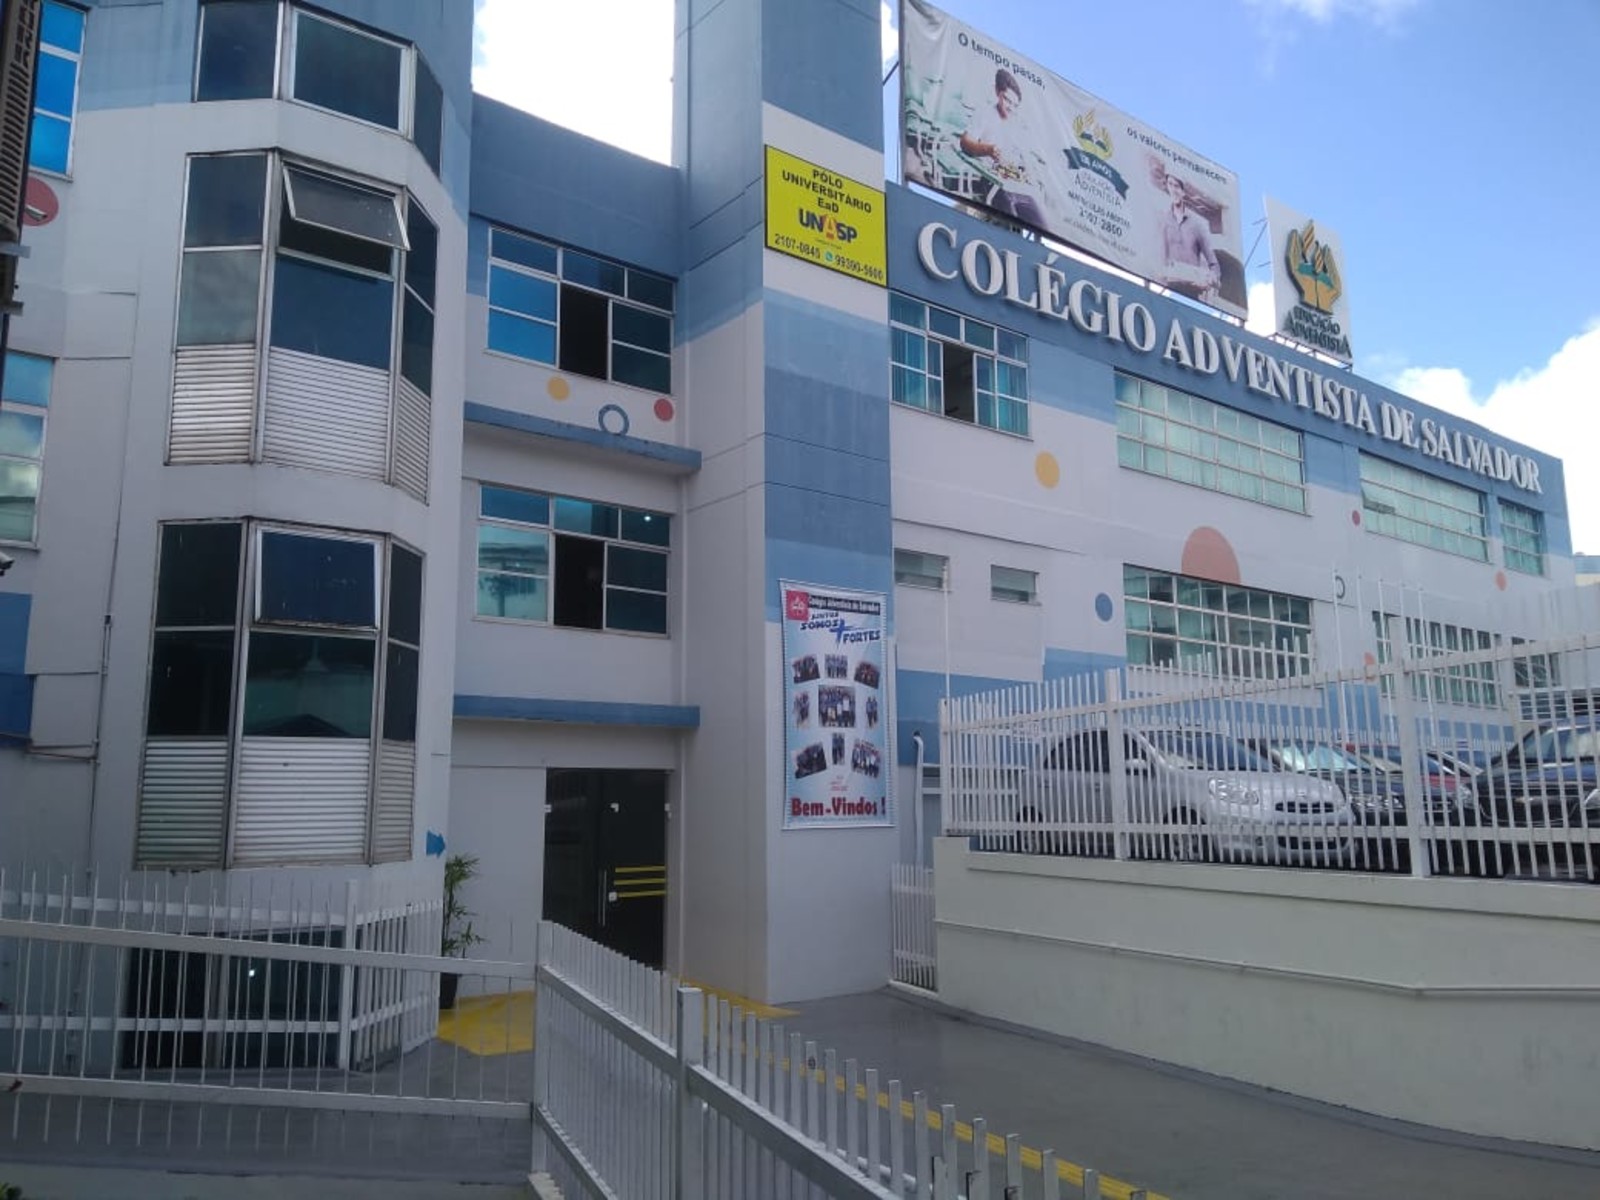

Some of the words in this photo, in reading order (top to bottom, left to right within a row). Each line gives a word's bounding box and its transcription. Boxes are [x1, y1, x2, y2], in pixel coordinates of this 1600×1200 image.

[958, 32, 969, 47] O
[971, 39, 1010, 67] tempo
[1011, 62, 1045, 90] passa,
[1126, 127, 1138, 139] os
[817, 197, 840, 213] EaD
[918, 222, 1156, 352] COLÉGIO
[1163, 317, 1378, 436] ADVENTISTA
[1380, 400, 1419, 449] DE
[1420, 418, 1543, 495] SALVADOR
[842, 629, 881, 644] FORTES
